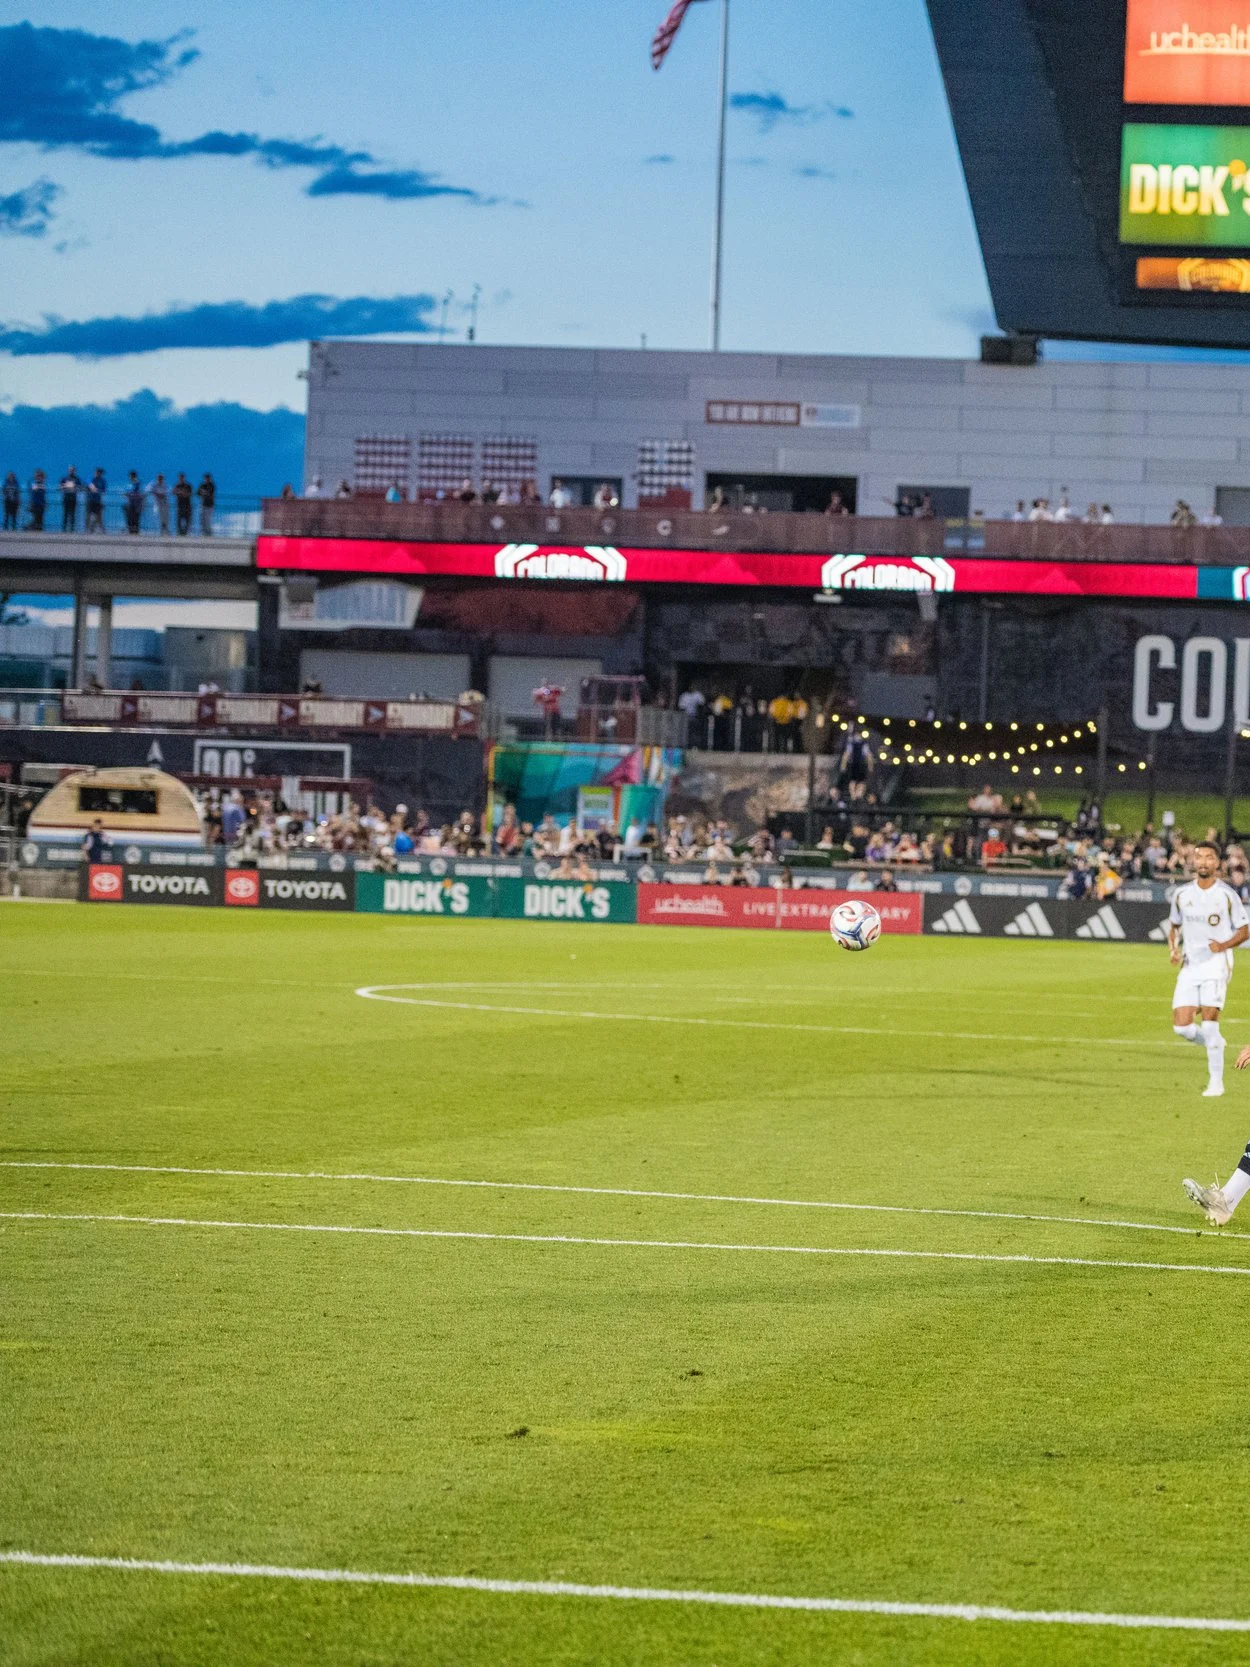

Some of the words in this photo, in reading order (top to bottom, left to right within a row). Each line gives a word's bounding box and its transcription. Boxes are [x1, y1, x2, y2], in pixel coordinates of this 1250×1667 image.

[128, 874, 210, 895] TOYOTA
[264, 879, 347, 900] TOYOTA
[383, 878, 469, 914] DICK'S
[524, 884, 610, 918] DICK'S
[654, 894, 726, 916] uchealth
[742, 901, 776, 916] LIVE
[778, 902, 911, 922] EXTRAARY
